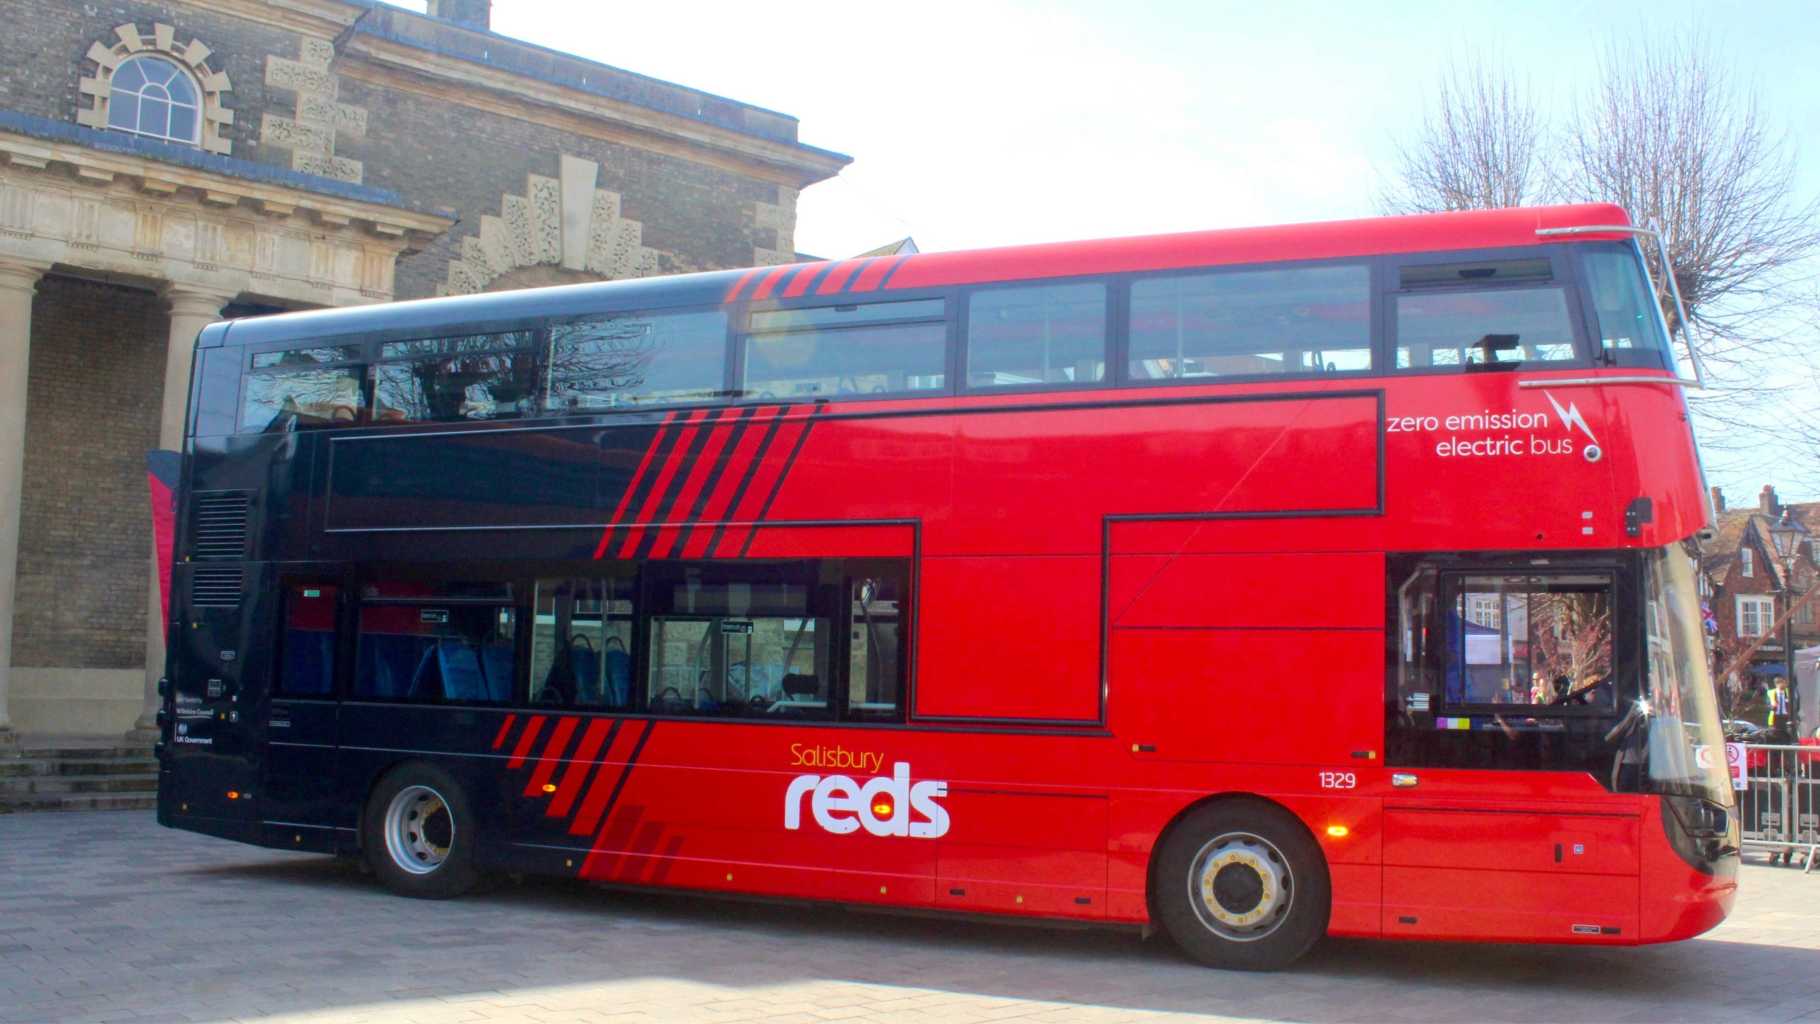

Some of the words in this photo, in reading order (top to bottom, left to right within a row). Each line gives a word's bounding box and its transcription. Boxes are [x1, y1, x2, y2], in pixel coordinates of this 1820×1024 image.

[1387, 415, 1439, 433] zero
[1445, 408, 1548, 431] emission
[1435, 435, 1523, 457] electric
[1530, 434, 1573, 455] bus
[176, 735, 184, 743] UK
[790, 743, 884, 774] Salisbury
[1319, 771, 1356, 789] 1329
[784, 761, 950, 839] reds
